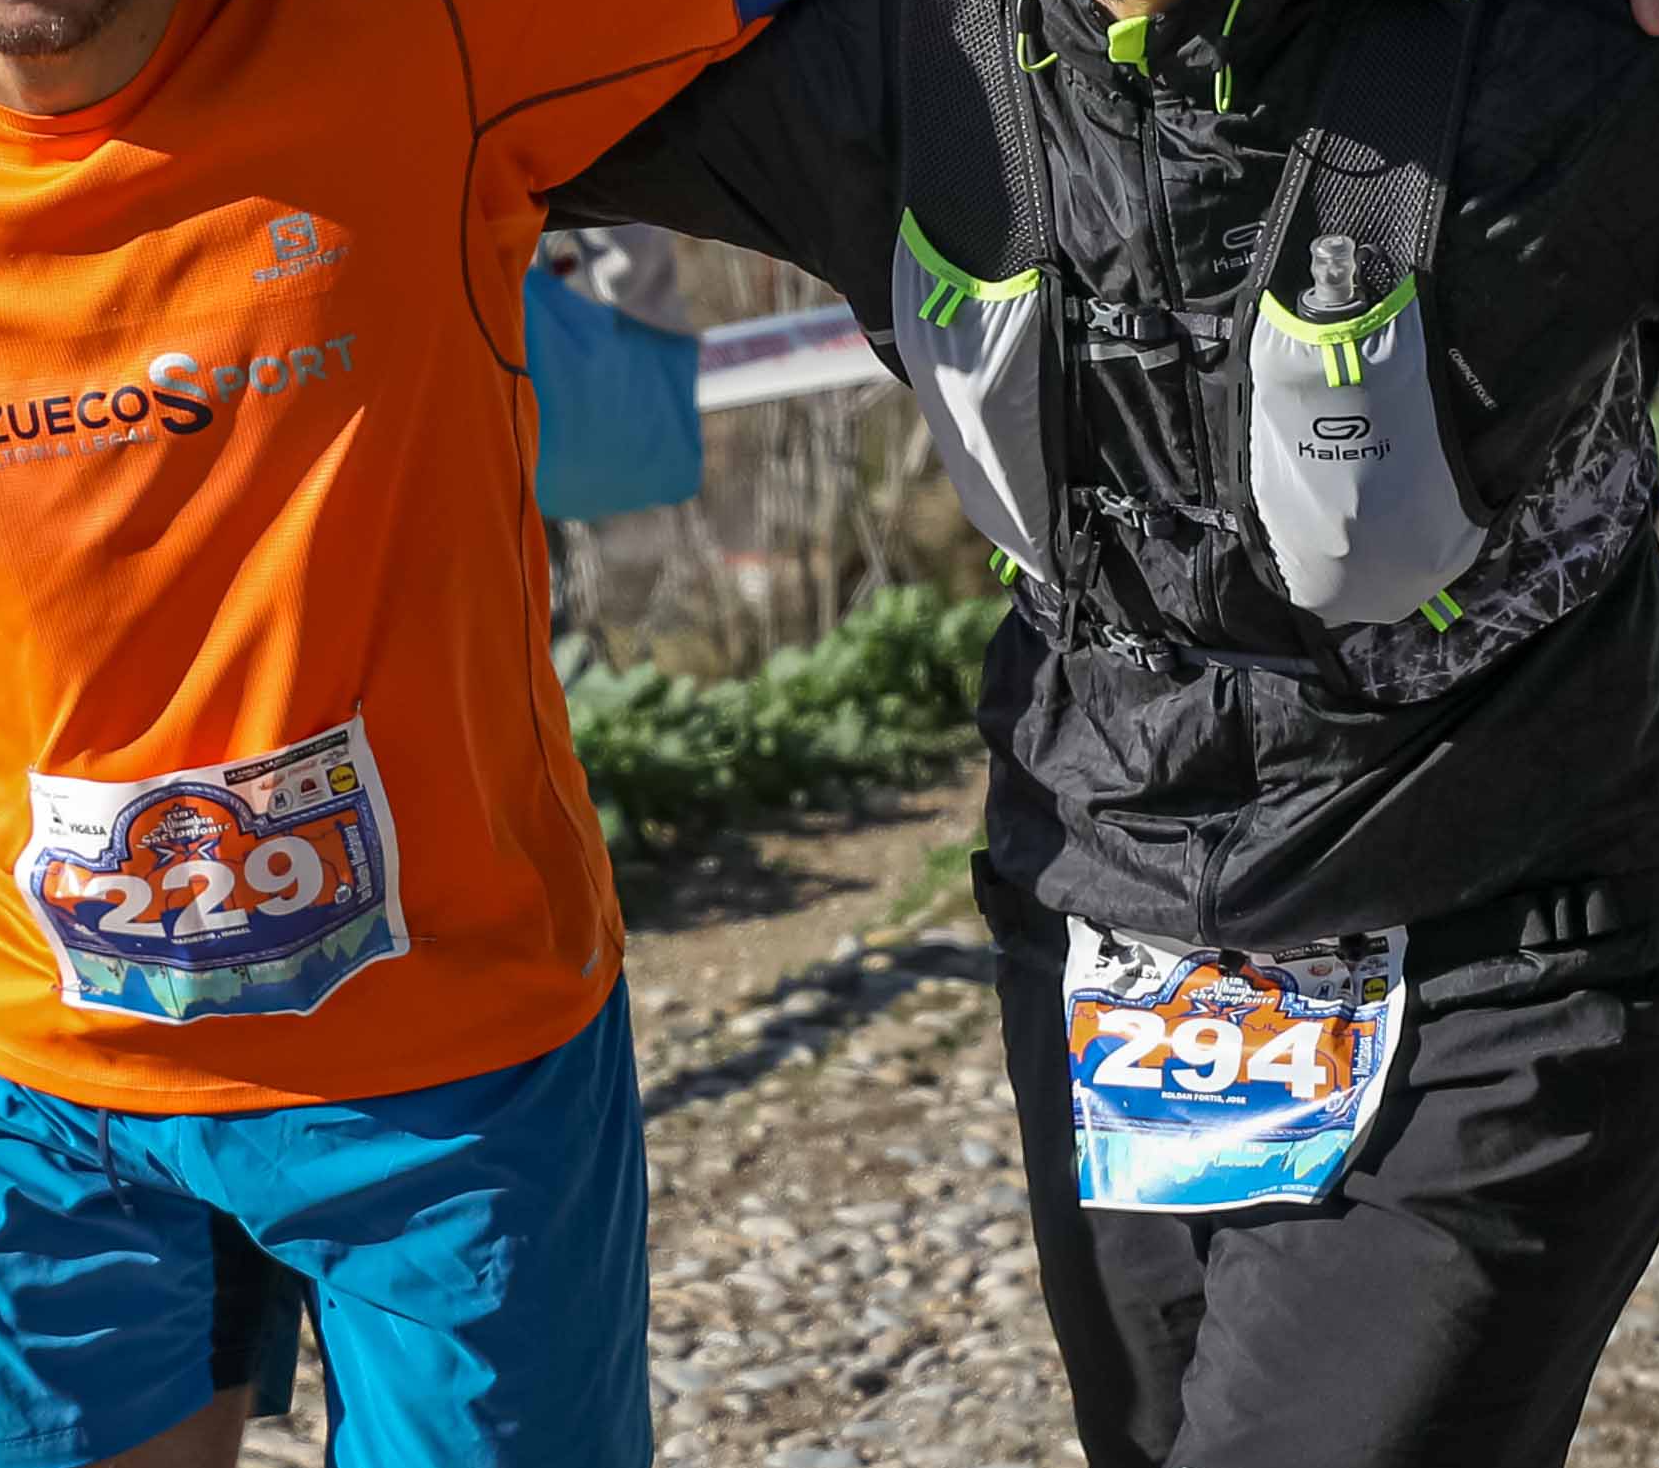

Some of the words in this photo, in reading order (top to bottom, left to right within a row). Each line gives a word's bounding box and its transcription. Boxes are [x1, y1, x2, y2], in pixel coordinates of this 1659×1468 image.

[1297, 437, 1391, 462] Kalenji
[82, 835, 325, 939] 229
[1091, 1009, 1328, 1099] 294
